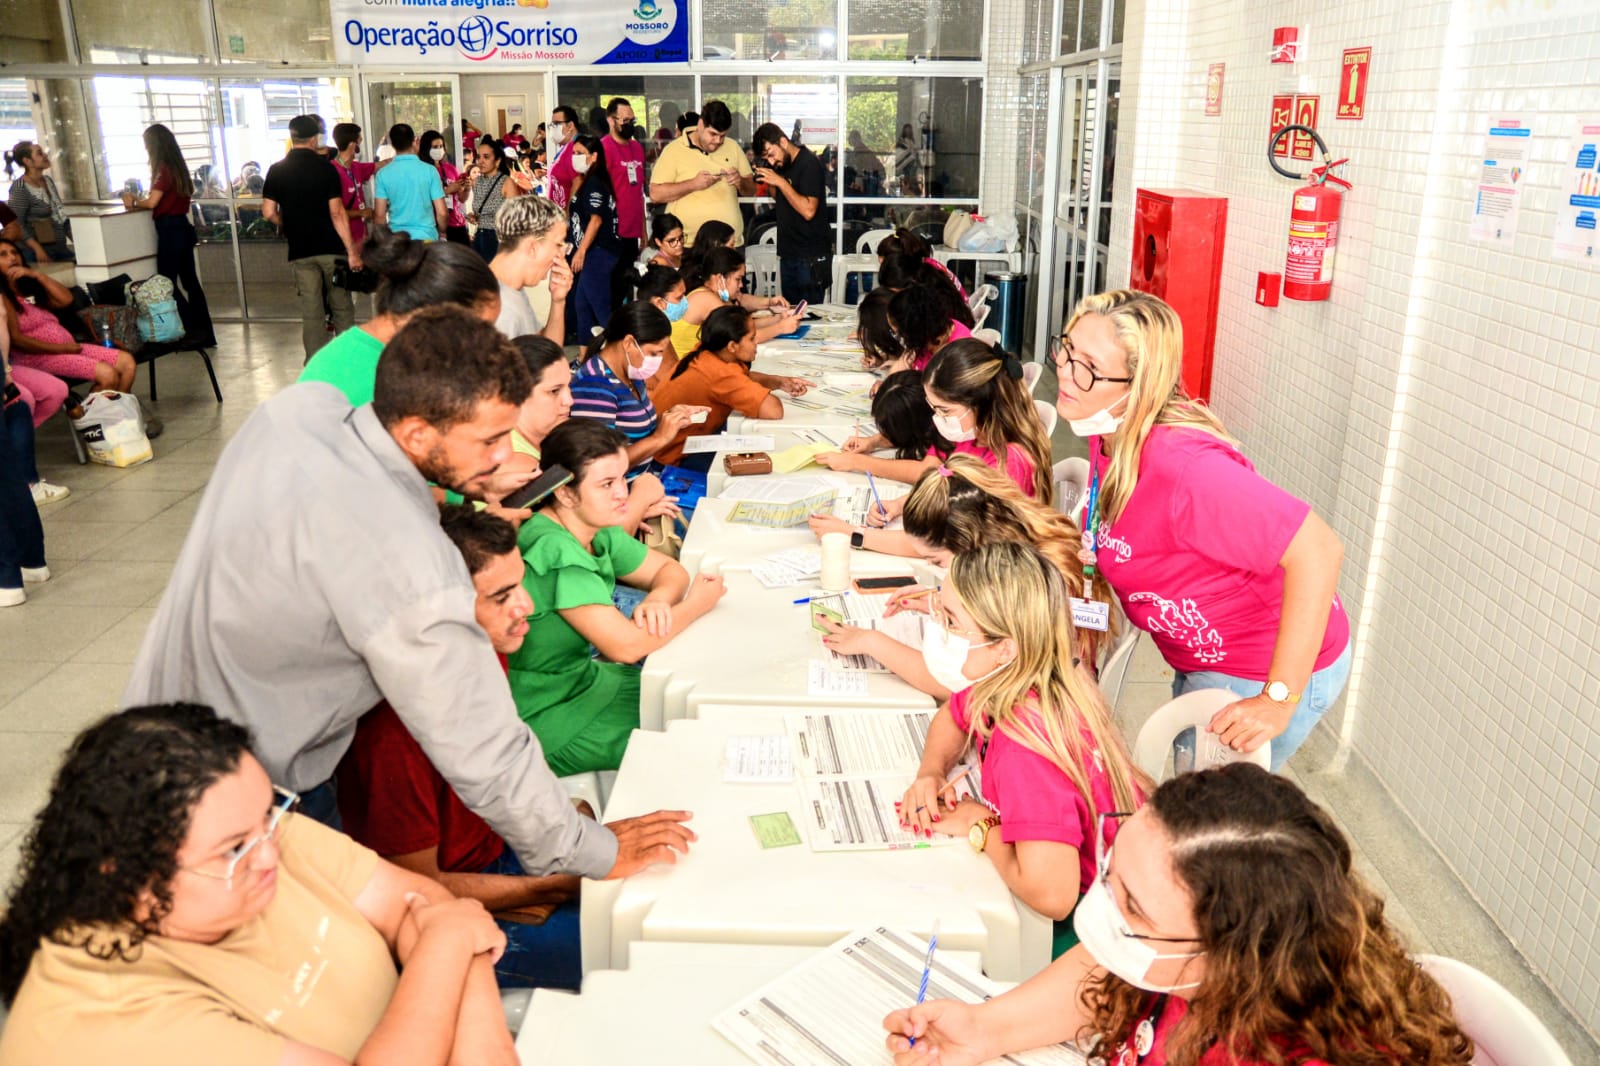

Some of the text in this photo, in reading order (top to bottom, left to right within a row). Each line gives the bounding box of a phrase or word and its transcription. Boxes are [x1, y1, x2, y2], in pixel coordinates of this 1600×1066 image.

[345, 20, 577, 54] Operação Sorriso
[501, 50, 575, 60] Missão Mossoró
